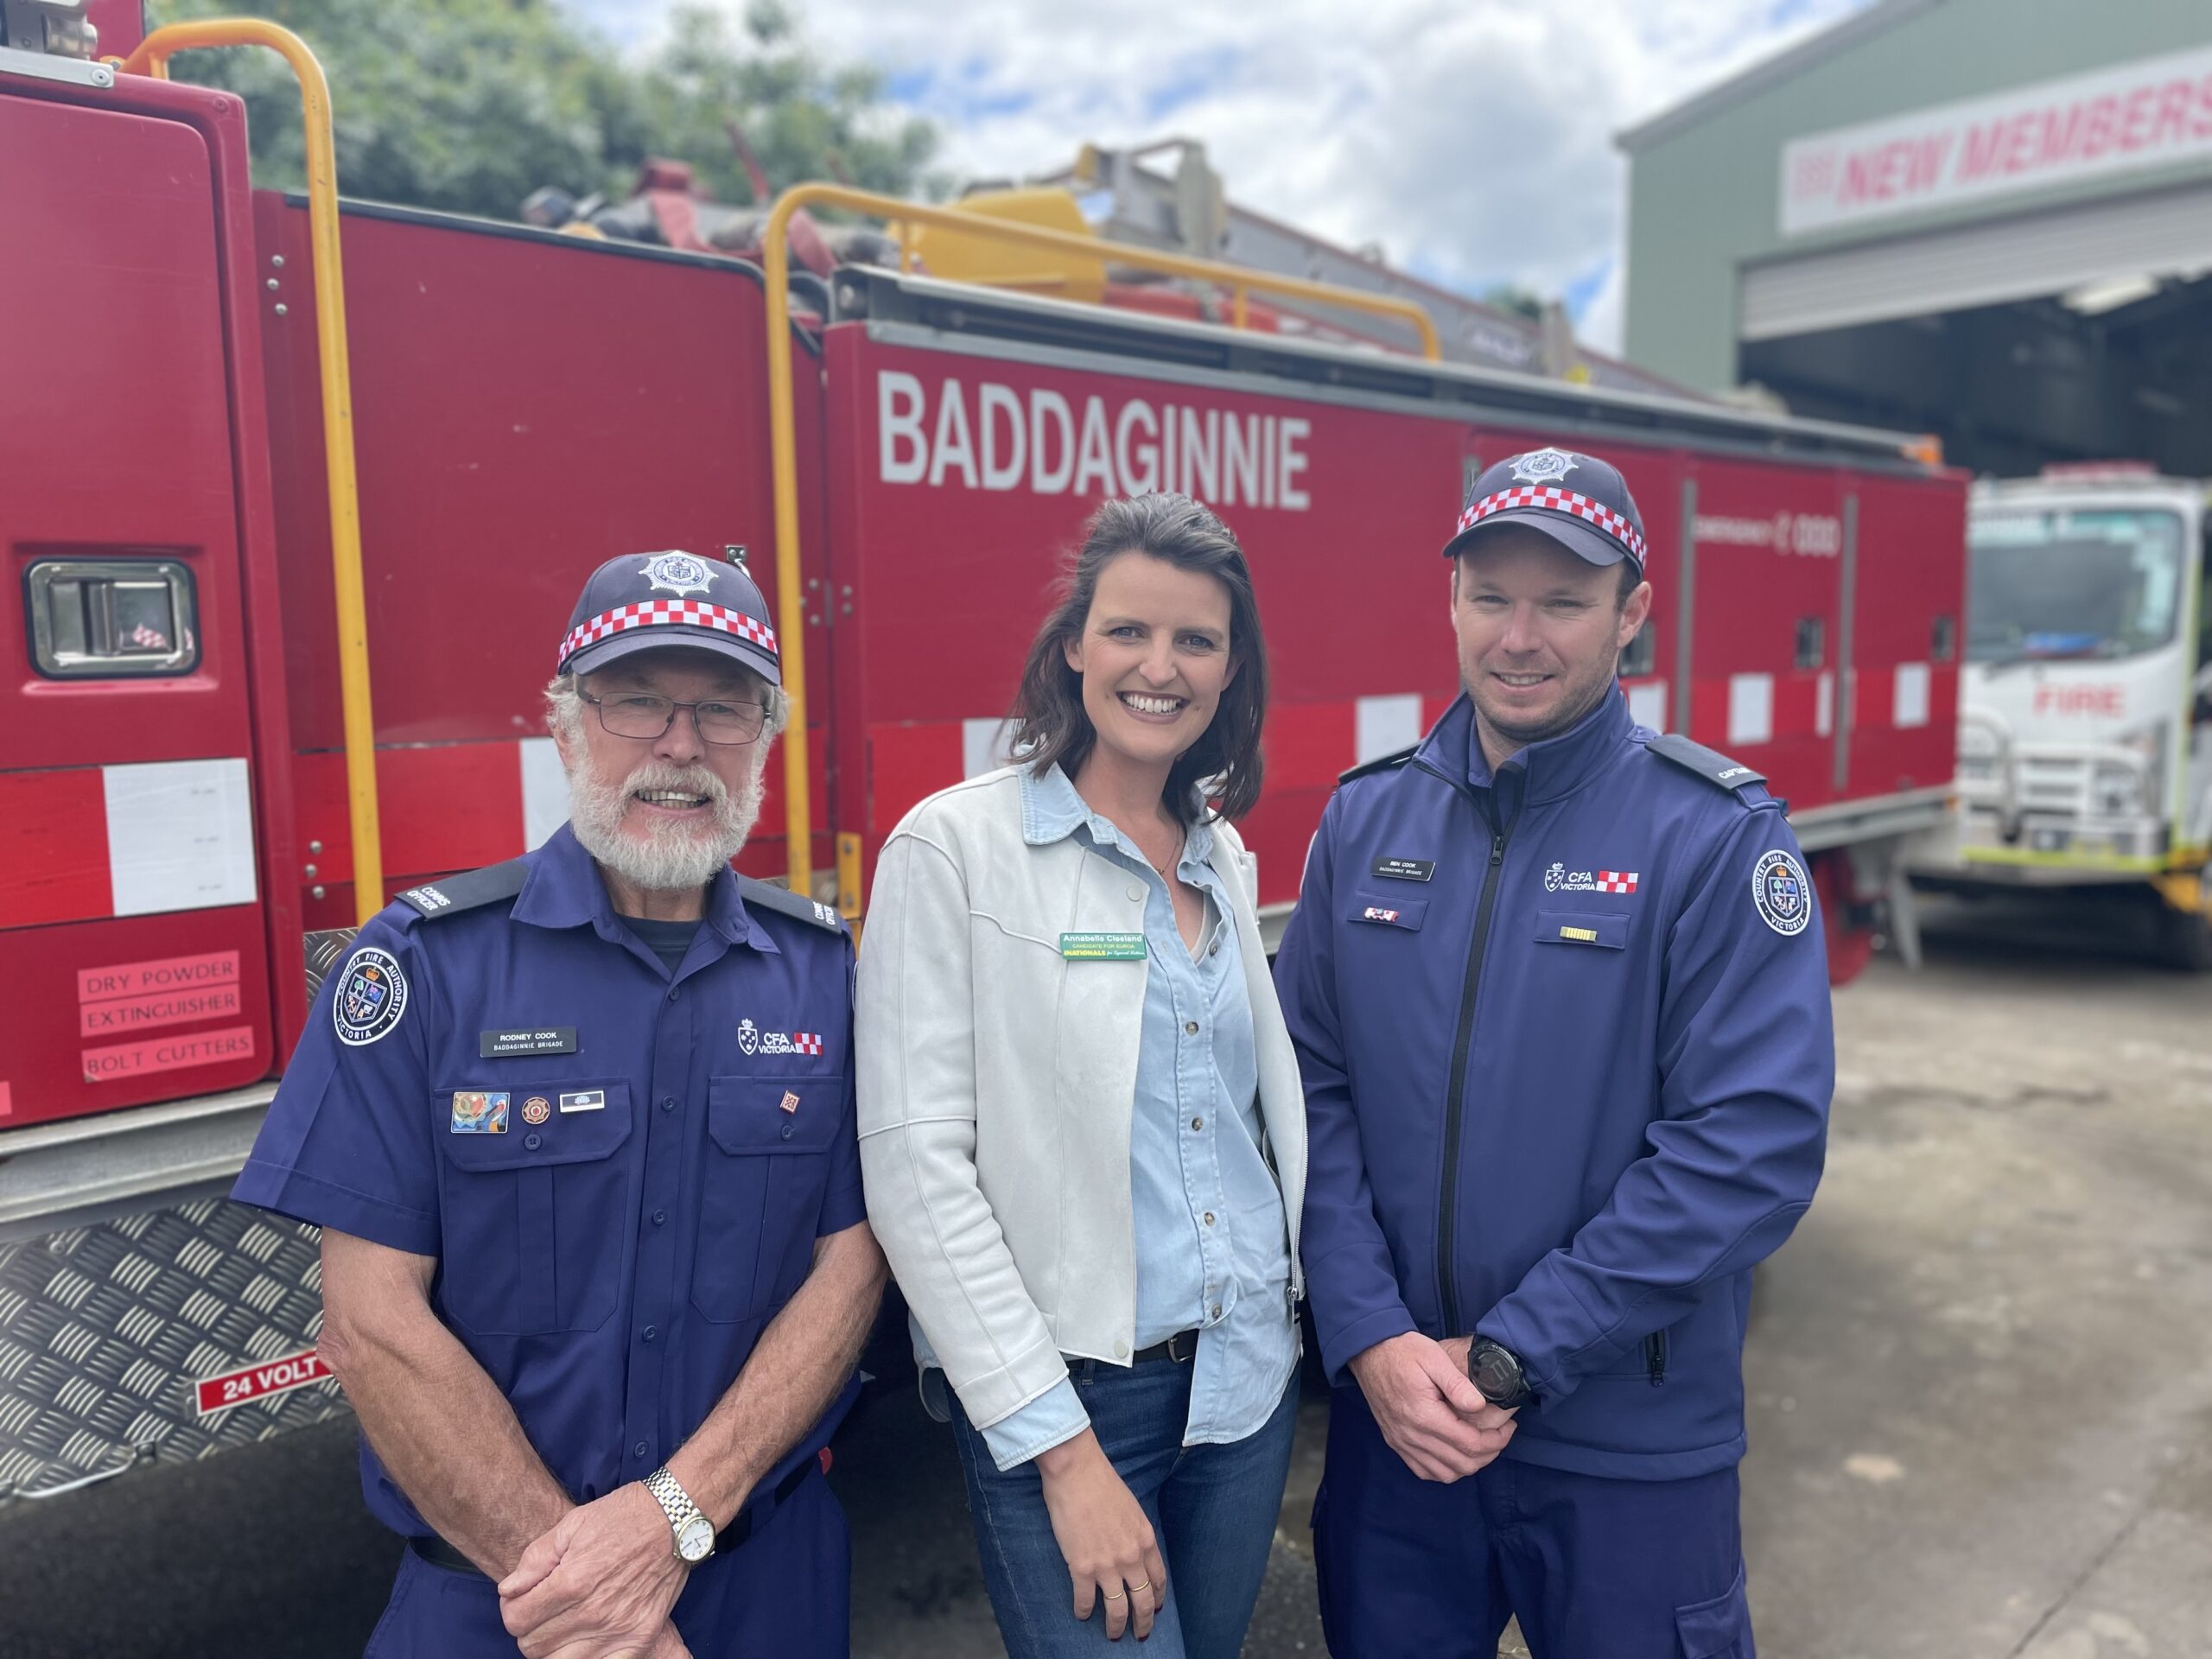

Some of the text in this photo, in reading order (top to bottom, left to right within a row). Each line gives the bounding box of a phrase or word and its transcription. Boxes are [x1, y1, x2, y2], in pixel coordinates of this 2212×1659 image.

[1839, 125, 1955, 208] NEW
[878, 370, 1310, 511] BADDAGINNIE
[2032, 683, 2125, 718] FIRE
[1560, 882, 1596, 891] VICTORIA
[1568, 872, 1592, 883] CFA
[1756, 862, 1767, 903] COUNTRY
[1768, 855, 1783, 864] FIRE
[1770, 916, 1805, 931] VICTORIA
[87, 960, 235, 994] DRY POWDER
[365, 953, 384, 964] FIRE
[386, 964, 403, 1020] AUTHORITY
[87, 995, 236, 1027] EXTINGUISHER
[337, 1014, 372, 1039] VICTORIA
[493, 1042, 535, 1051] BADDAGINNIE
[499, 1033, 531, 1042] RODNEY
[758, 1044, 796, 1054] VICTORIA
[763, 1033, 790, 1046] CFA
[86, 1037, 251, 1074] BOLT CUTTERS
[223, 1356, 318, 1401] 24 VOLT
